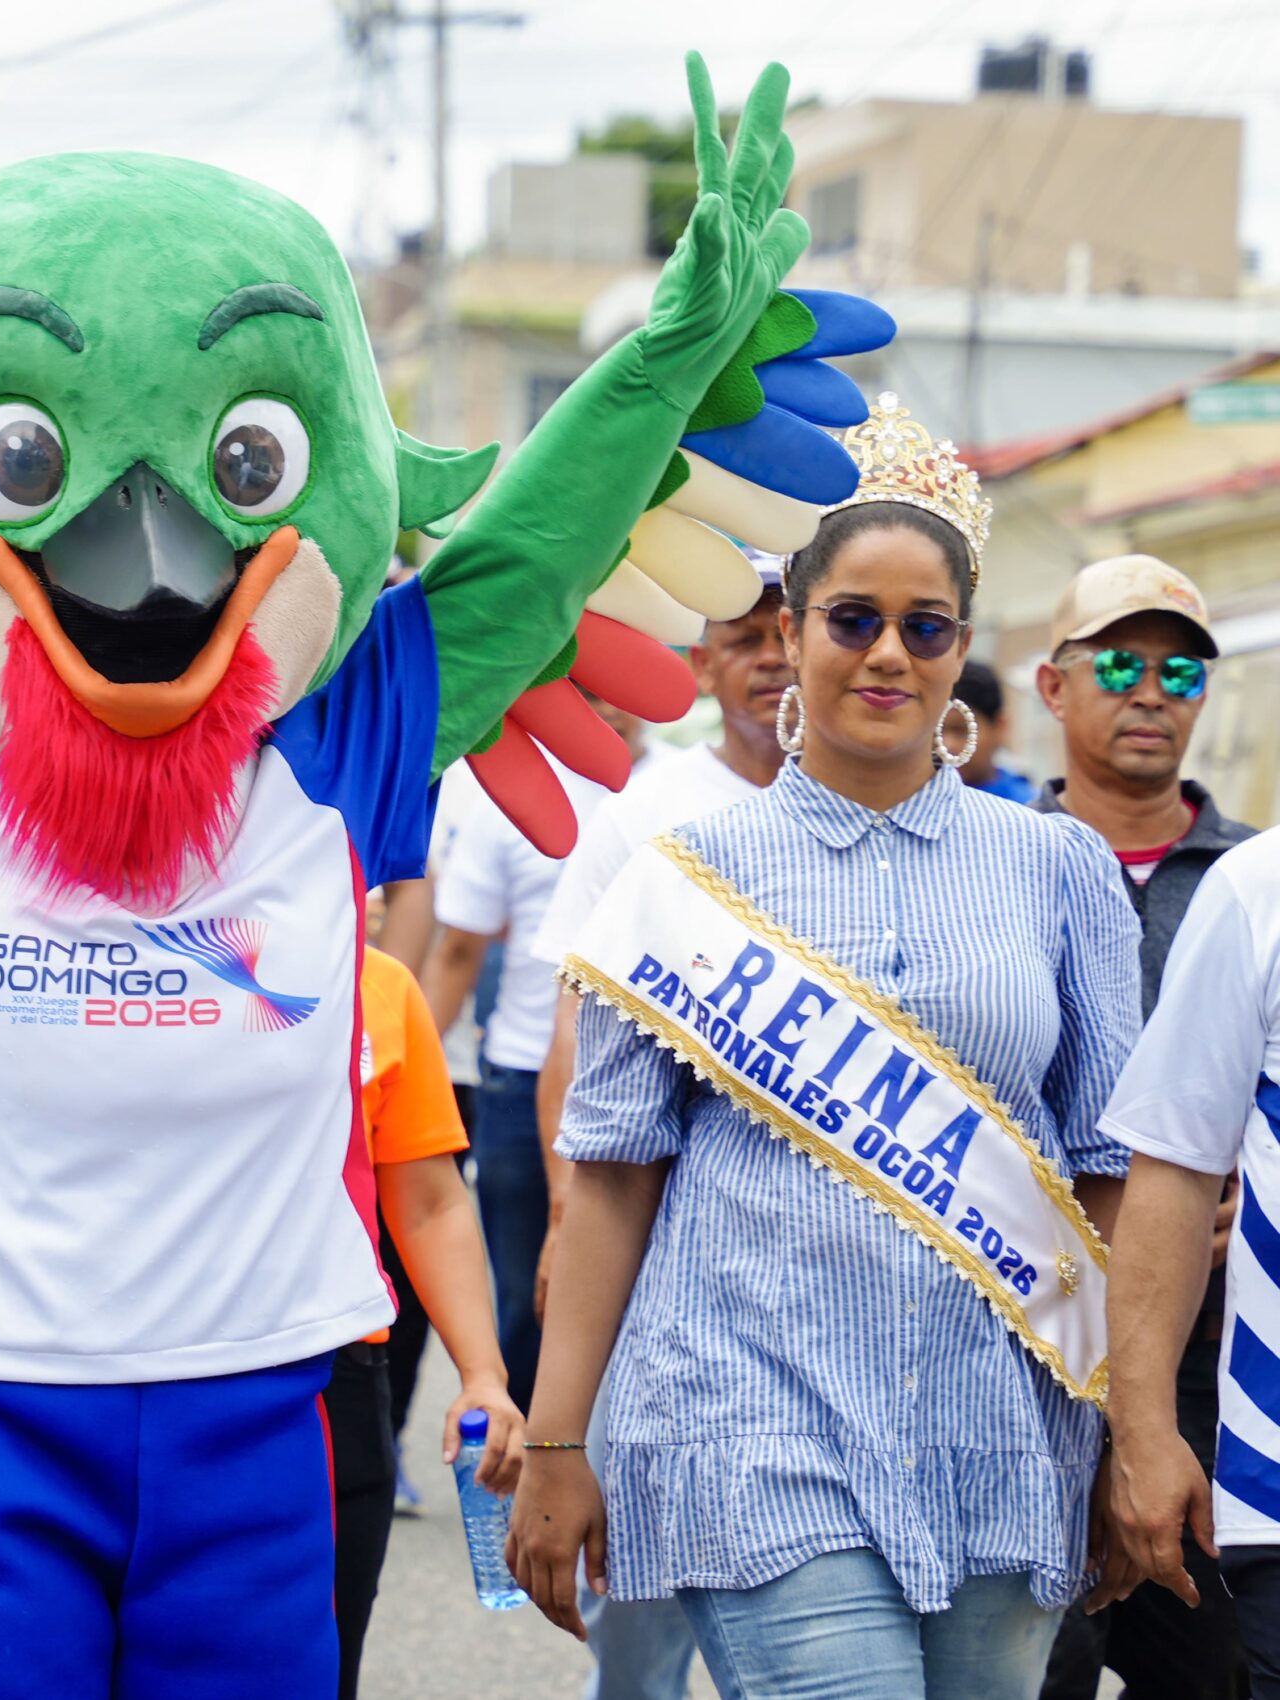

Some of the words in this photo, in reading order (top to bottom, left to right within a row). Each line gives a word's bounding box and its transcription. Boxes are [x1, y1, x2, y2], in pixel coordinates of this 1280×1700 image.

[11, 994, 34, 1004] XXV
[36, 996, 79, 1007] Juegos
[84, 998, 223, 1028] 2026
[10, 1015, 17, 1024] y
[19, 1014, 37, 1024] del
[40, 1015, 78, 1026] Caribe
[705, 939, 984, 1182] REINA
[628, 954, 852, 1135] PATRONALES
[852, 1124, 957, 1217] OCOA
[955, 1206, 1038, 1297] 2026
